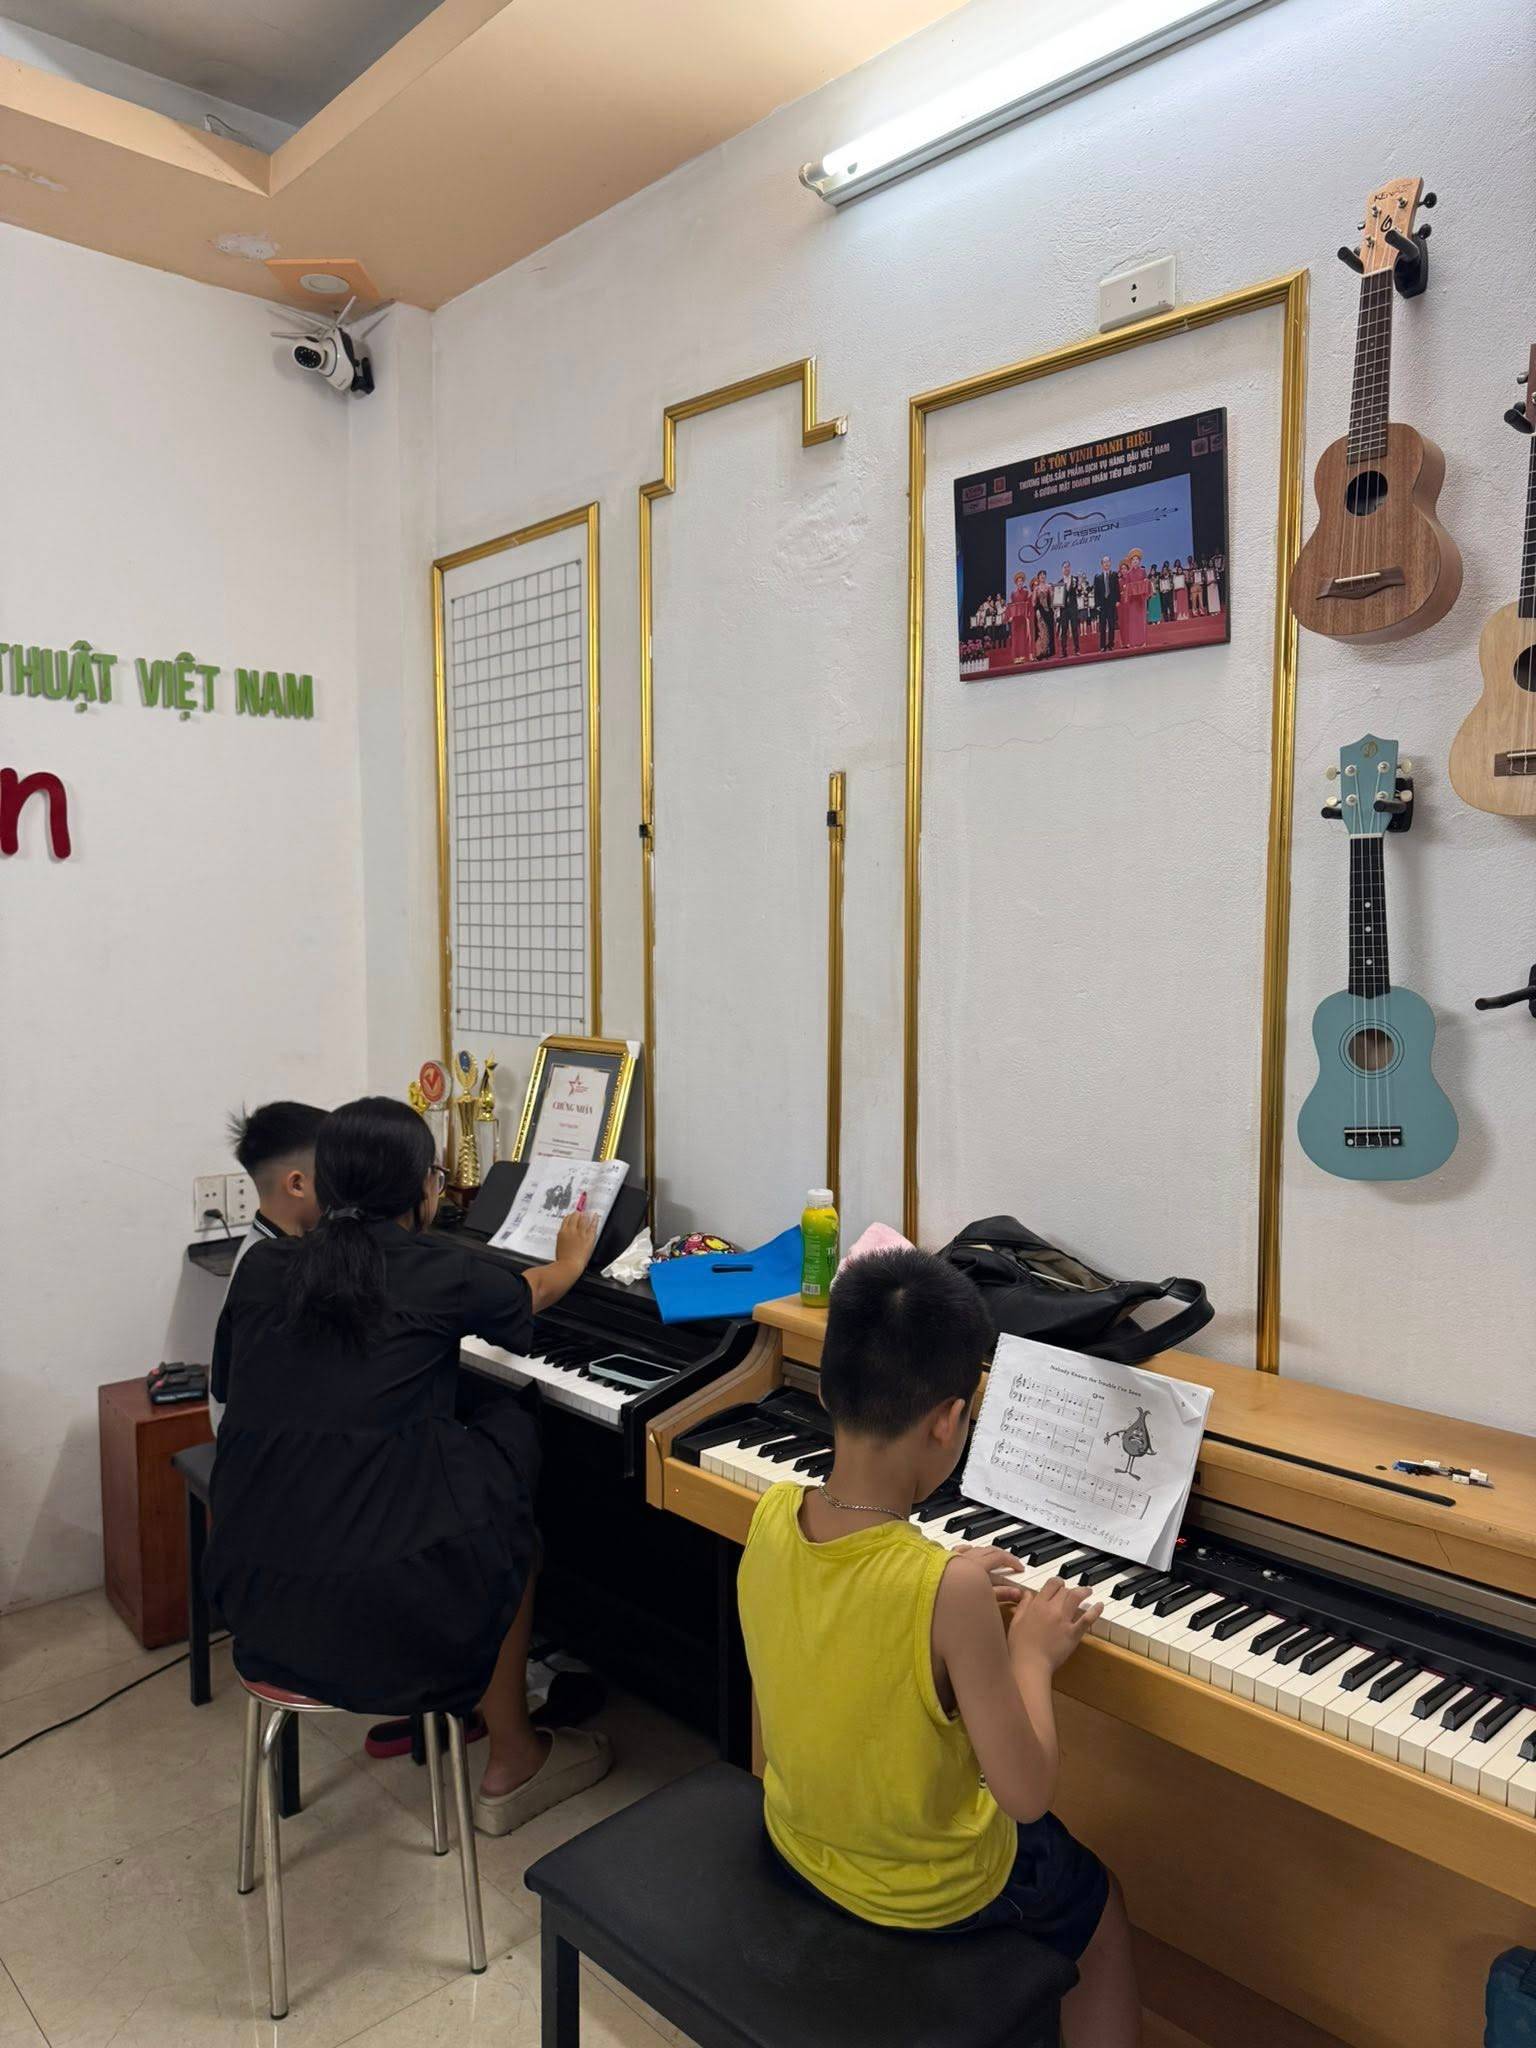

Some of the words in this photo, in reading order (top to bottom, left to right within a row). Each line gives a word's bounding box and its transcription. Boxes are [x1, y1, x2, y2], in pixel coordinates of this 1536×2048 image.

[1048, 452, 1068, 470] TÔN
[1069, 446, 1094, 464] VINH
[1095, 438, 1124, 458] DANH
[1126, 430, 1153, 449] HIỆU
[1137, 460, 1153, 473] 2017
[1140, 447, 1155, 461] VIỆT
[1155, 443, 1170, 455] NAM
[135, 652, 220, 721] VIỆT
[234, 667, 314, 720] NAM
[0, 767, 71, 859] n
